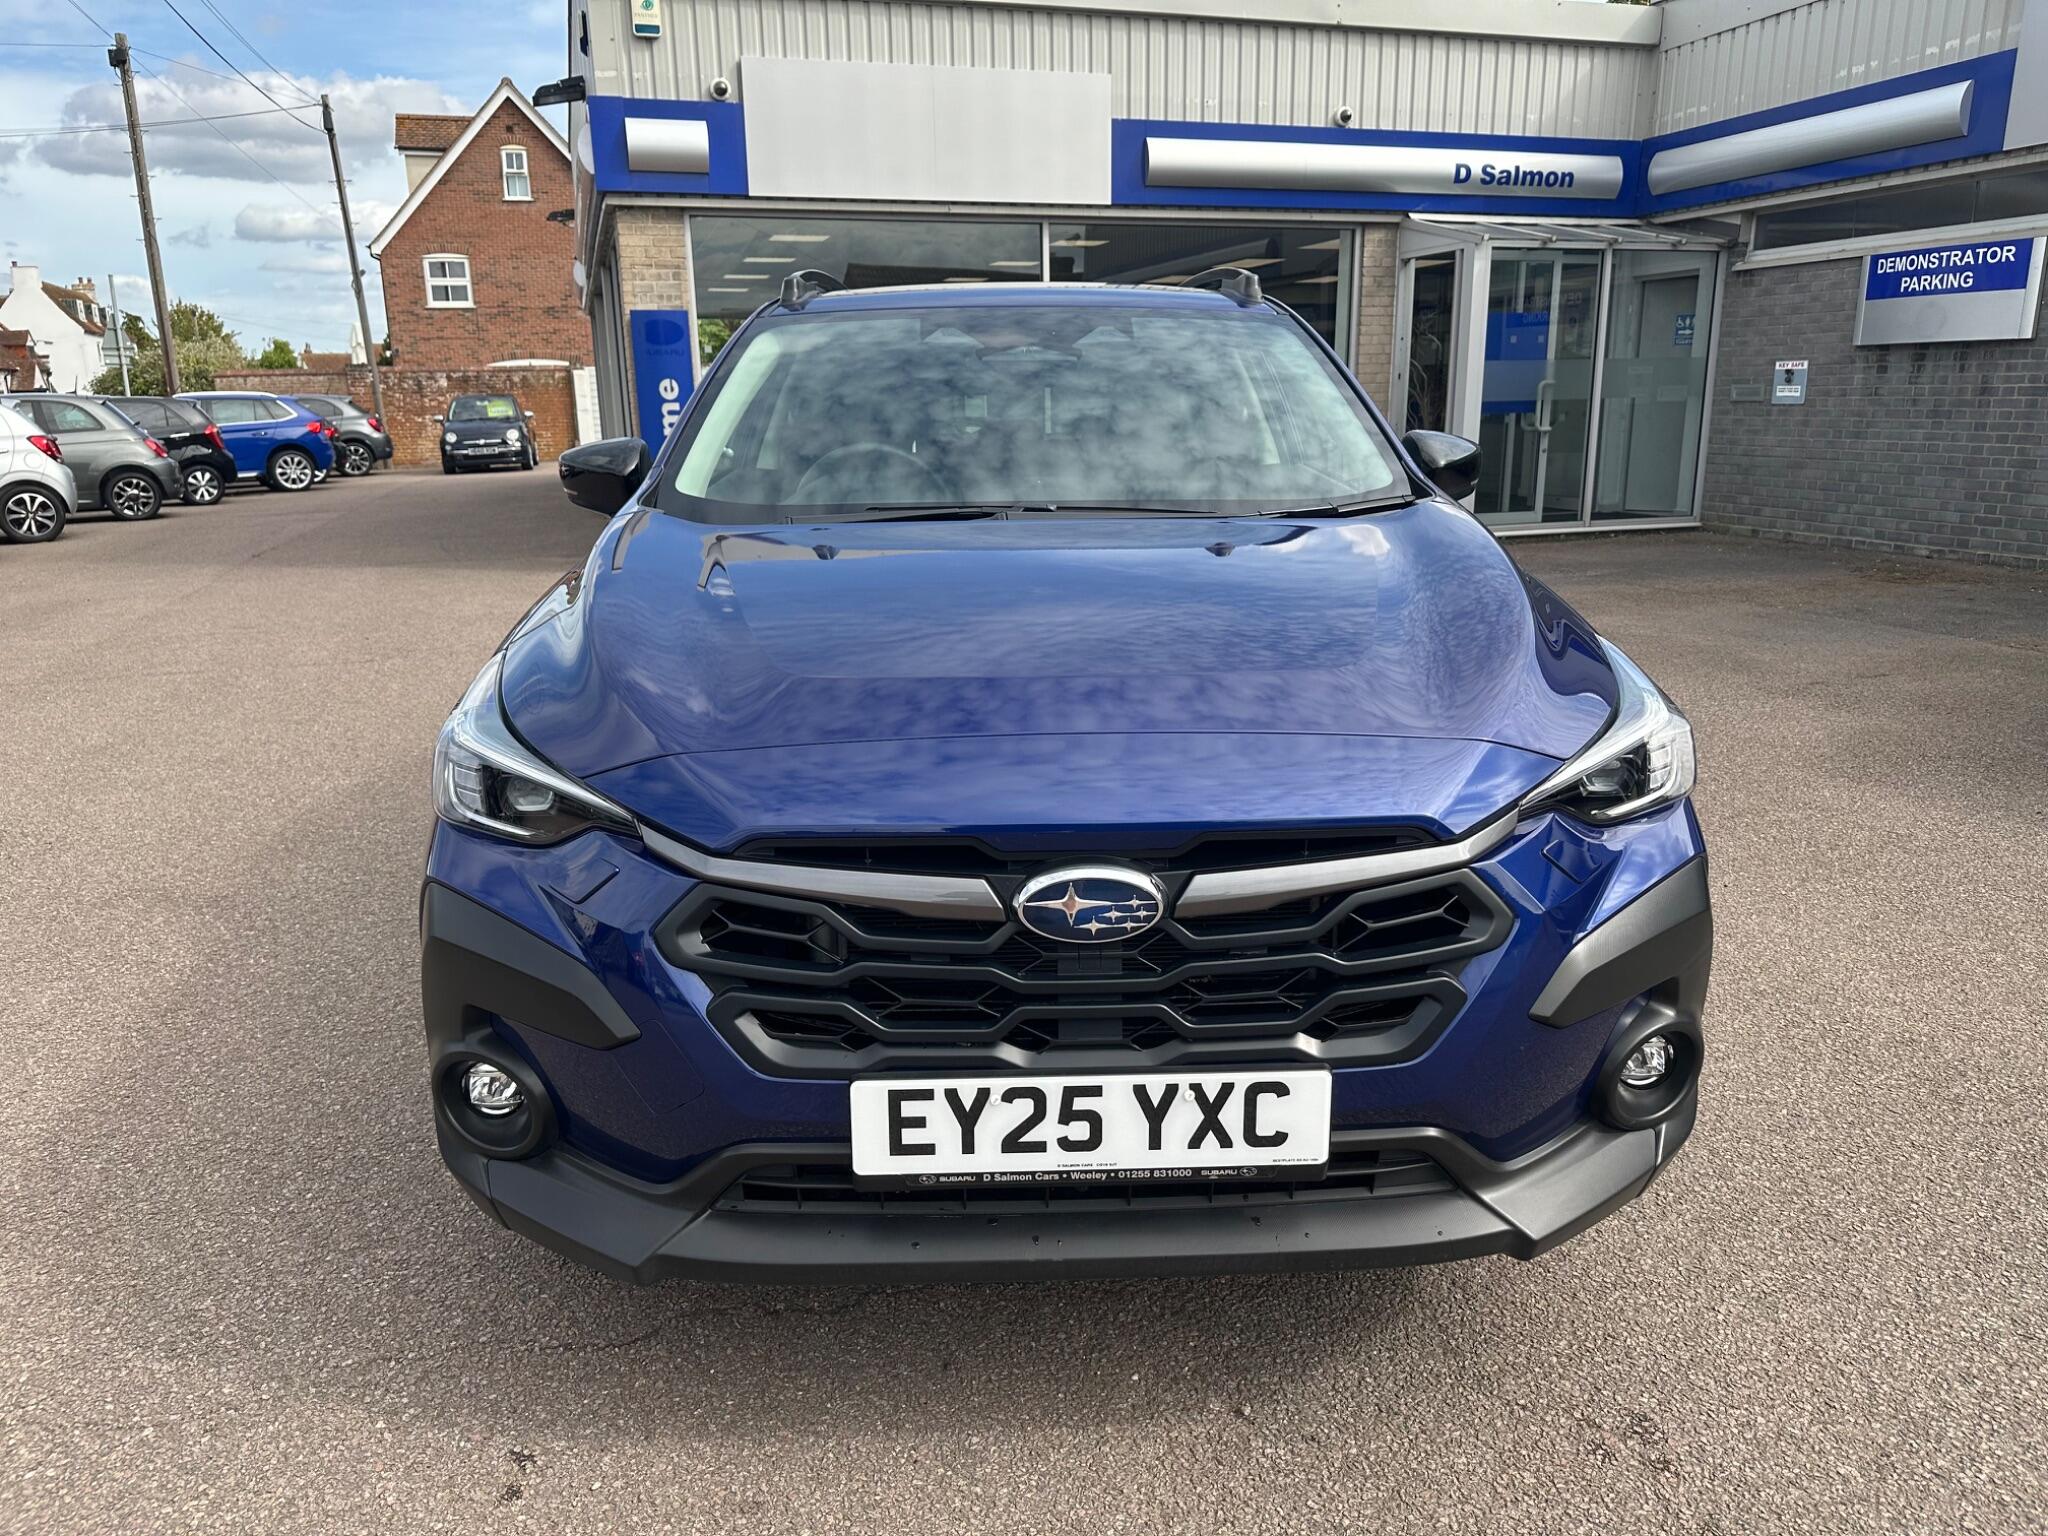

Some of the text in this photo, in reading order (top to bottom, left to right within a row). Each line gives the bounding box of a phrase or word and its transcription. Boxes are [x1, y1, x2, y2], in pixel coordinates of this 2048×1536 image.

[1453, 163, 1575, 188] D Salmon
[1877, 245, 2017, 274] DEMONSTRATOR
[1900, 271, 1974, 293] PARKING
[887, 1081, 1291, 1156] EY25 YXC
[983, 1169, 1192, 1182] D Salmon Cars Weeley 01255 831000
[1201, 1168, 1237, 1176] SUBARU
